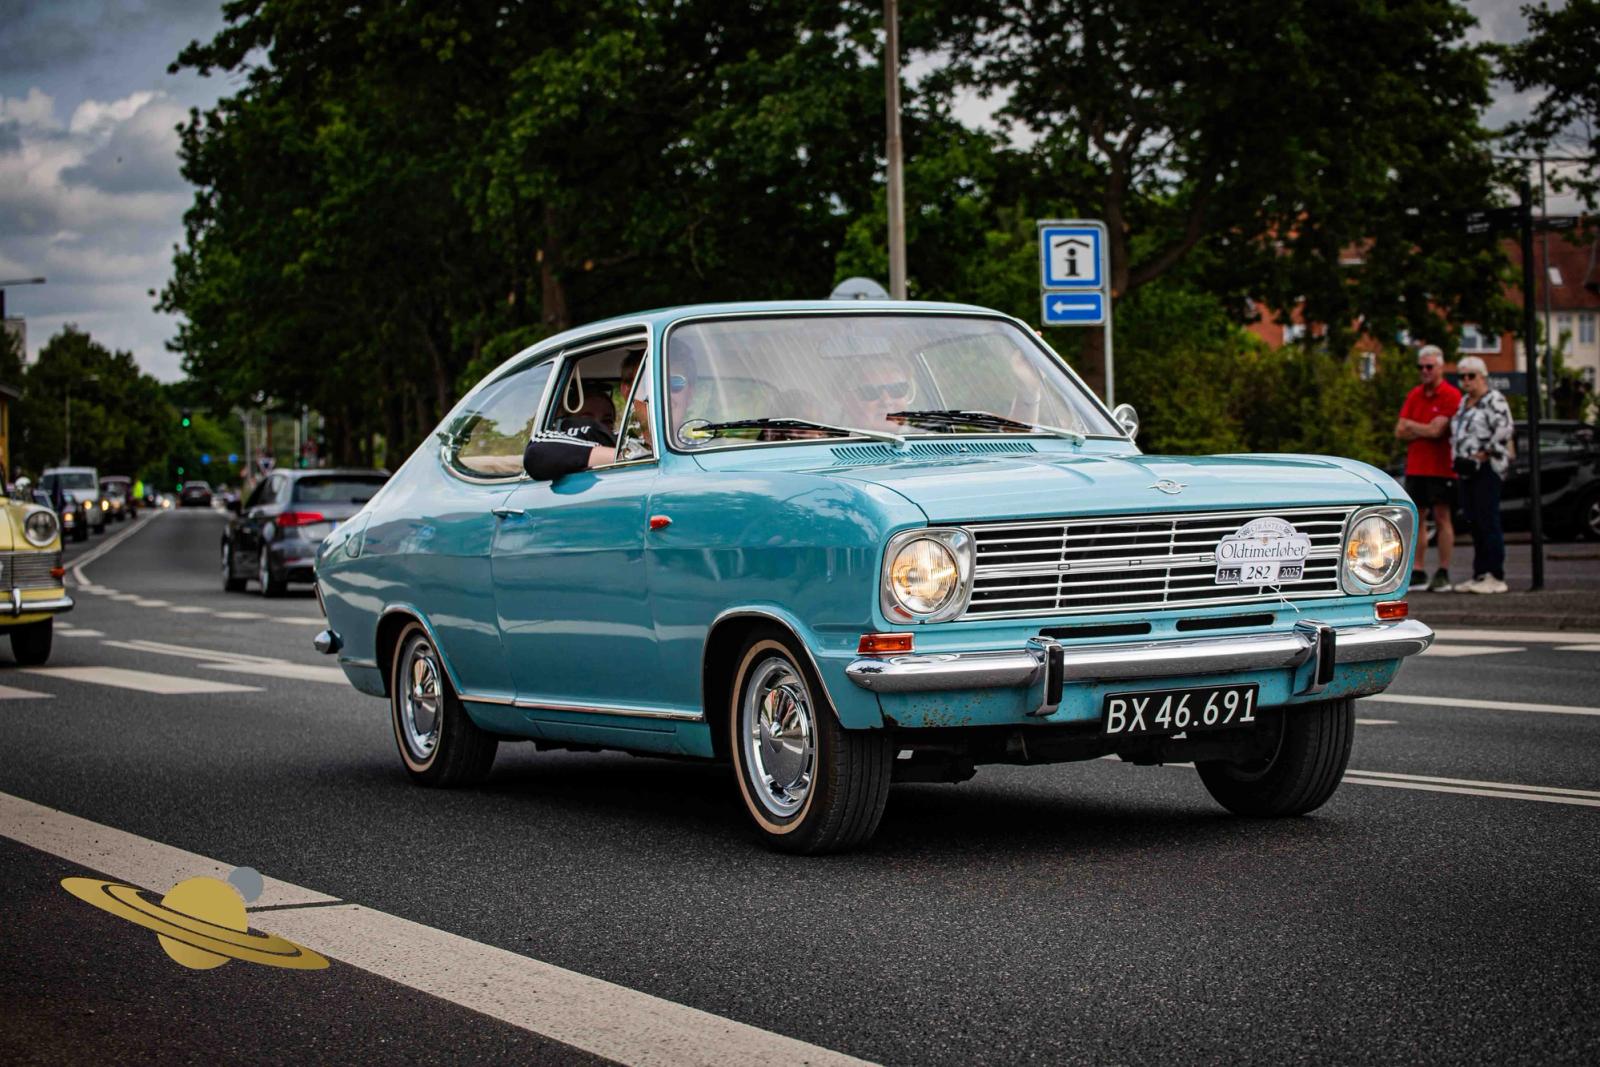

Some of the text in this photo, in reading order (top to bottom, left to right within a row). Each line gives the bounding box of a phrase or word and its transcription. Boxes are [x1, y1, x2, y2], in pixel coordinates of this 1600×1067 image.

[1246, 565, 1271, 580] 282
[1281, 567, 1300, 578] 2025
[1106, 688, 1256, 734] BX 46.691
